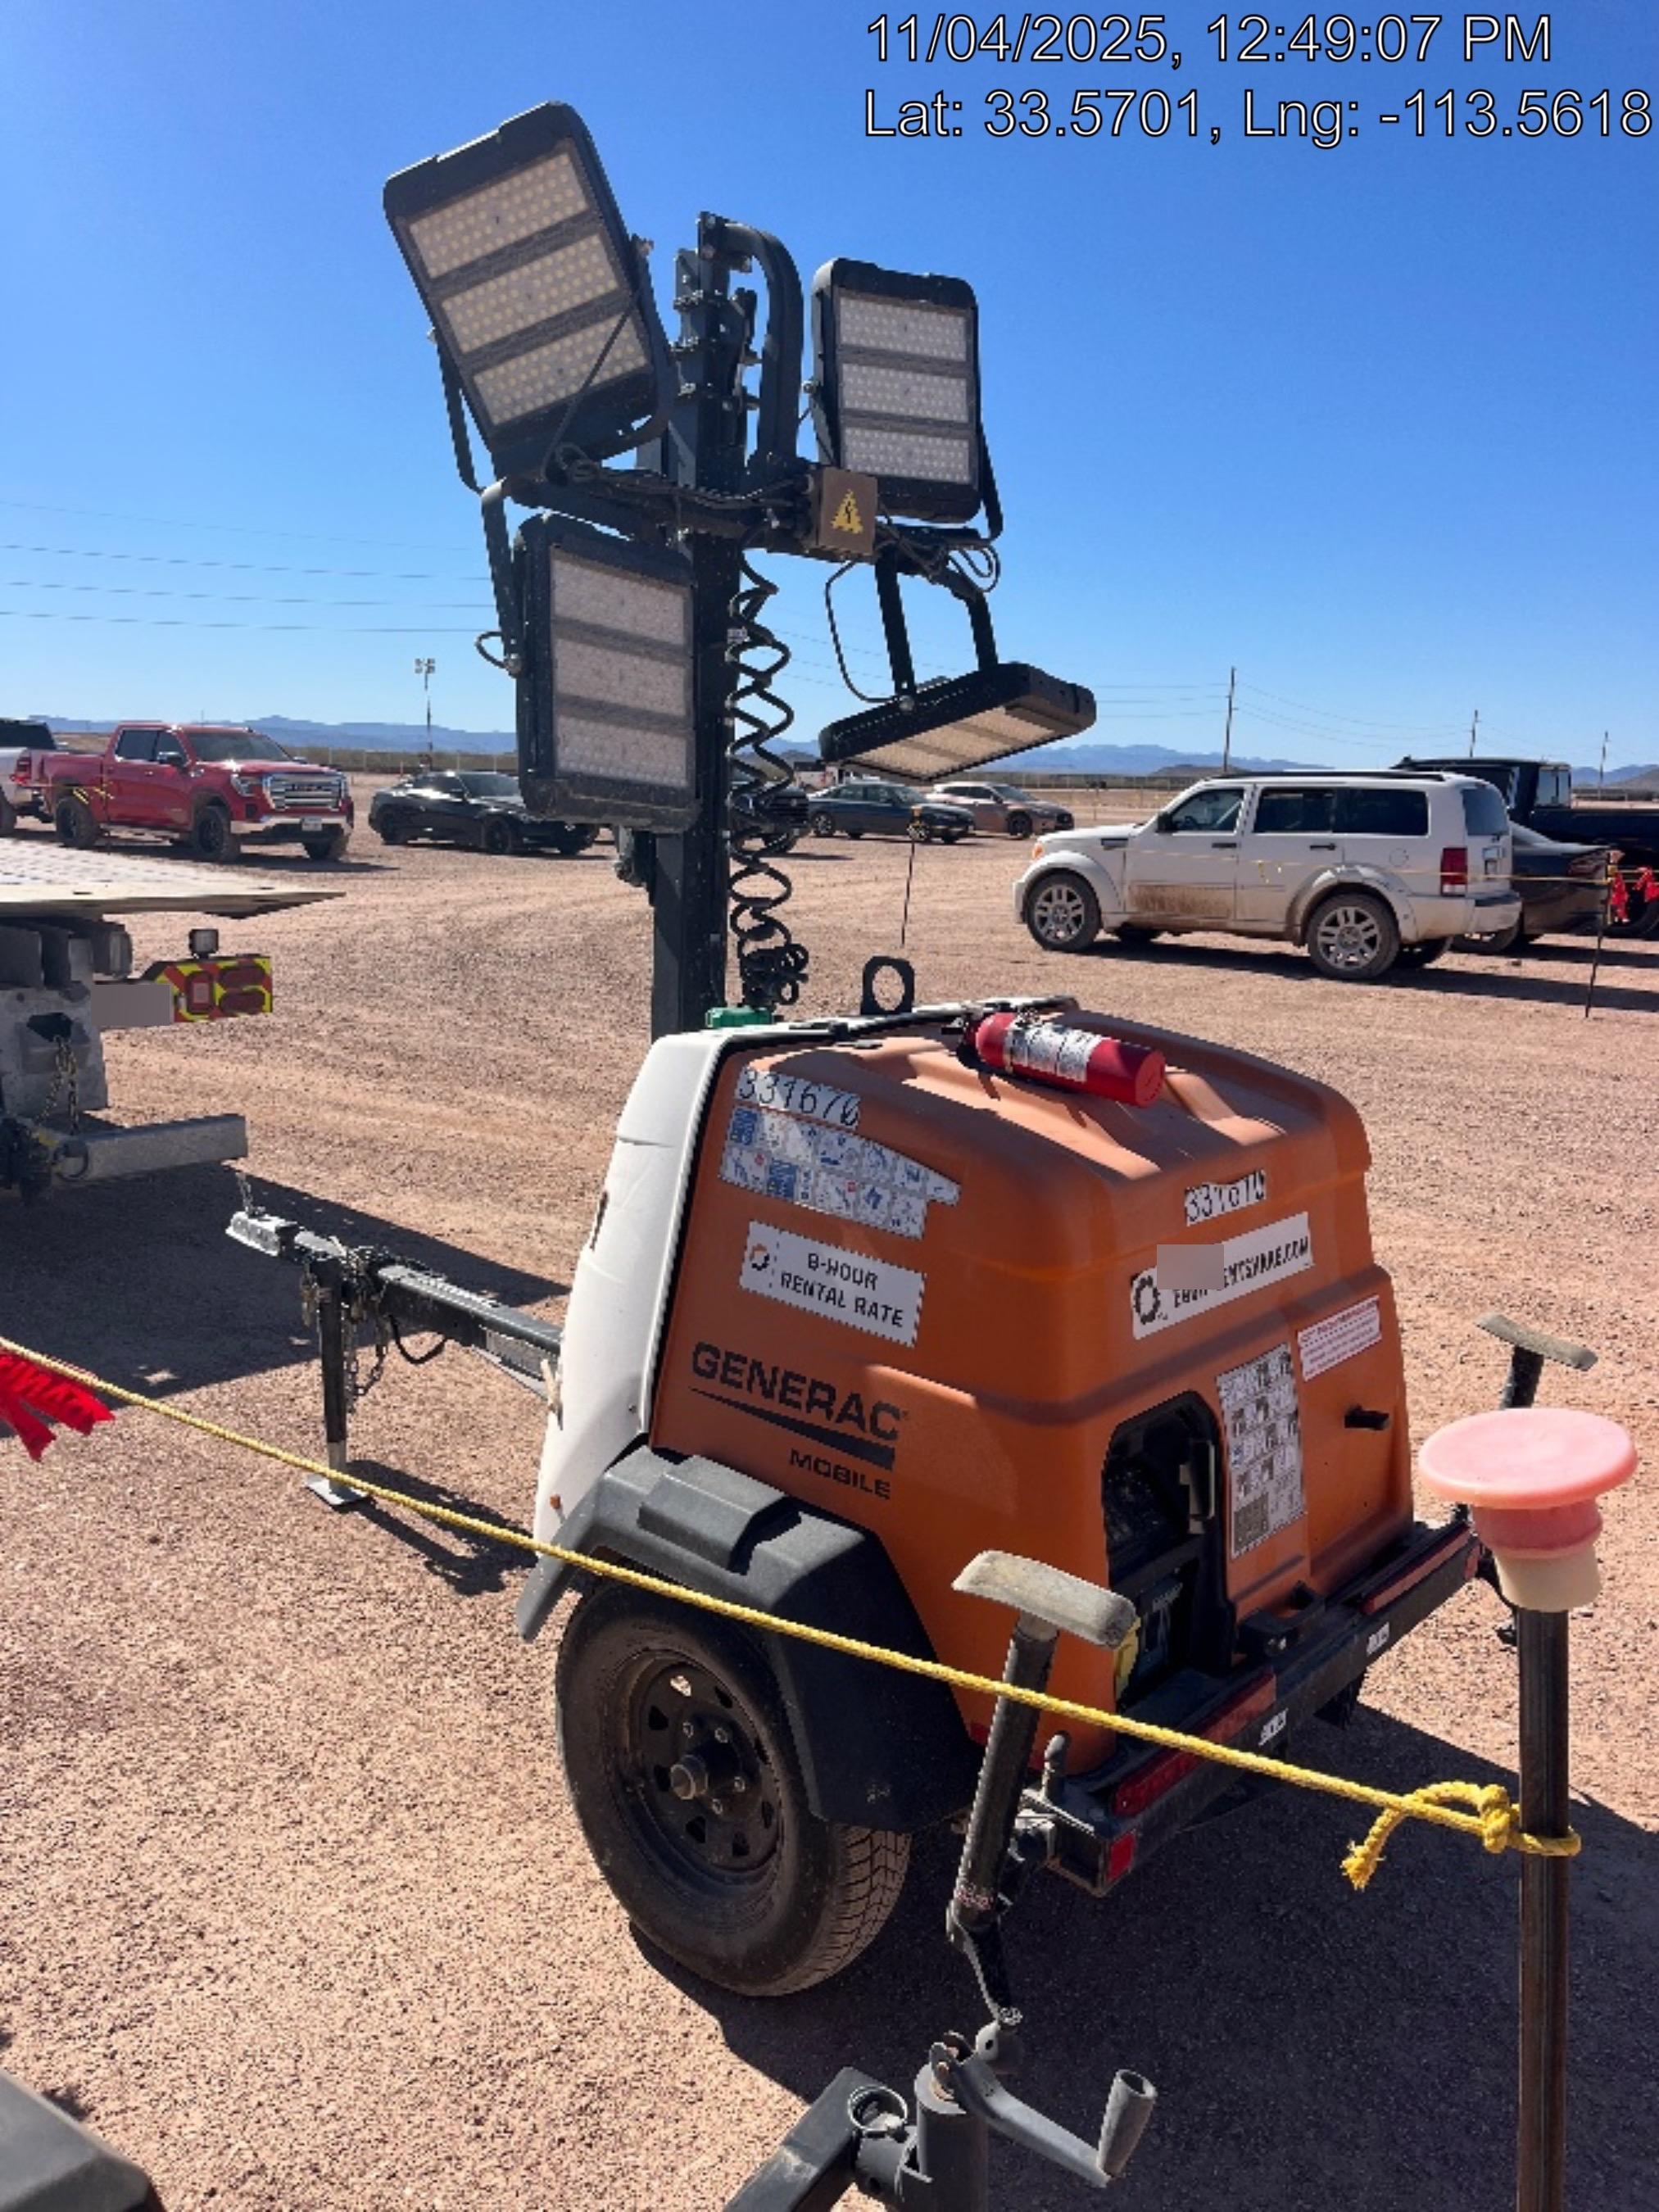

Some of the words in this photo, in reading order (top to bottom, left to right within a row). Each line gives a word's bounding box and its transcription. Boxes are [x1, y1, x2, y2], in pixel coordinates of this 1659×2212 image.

[780, 1272, 846, 1309] RENTAL
[854, 1297, 904, 1328] RATE
[692, 1341, 901, 1440] GENERAC
[789, 1448, 891, 1500] MOBILE
